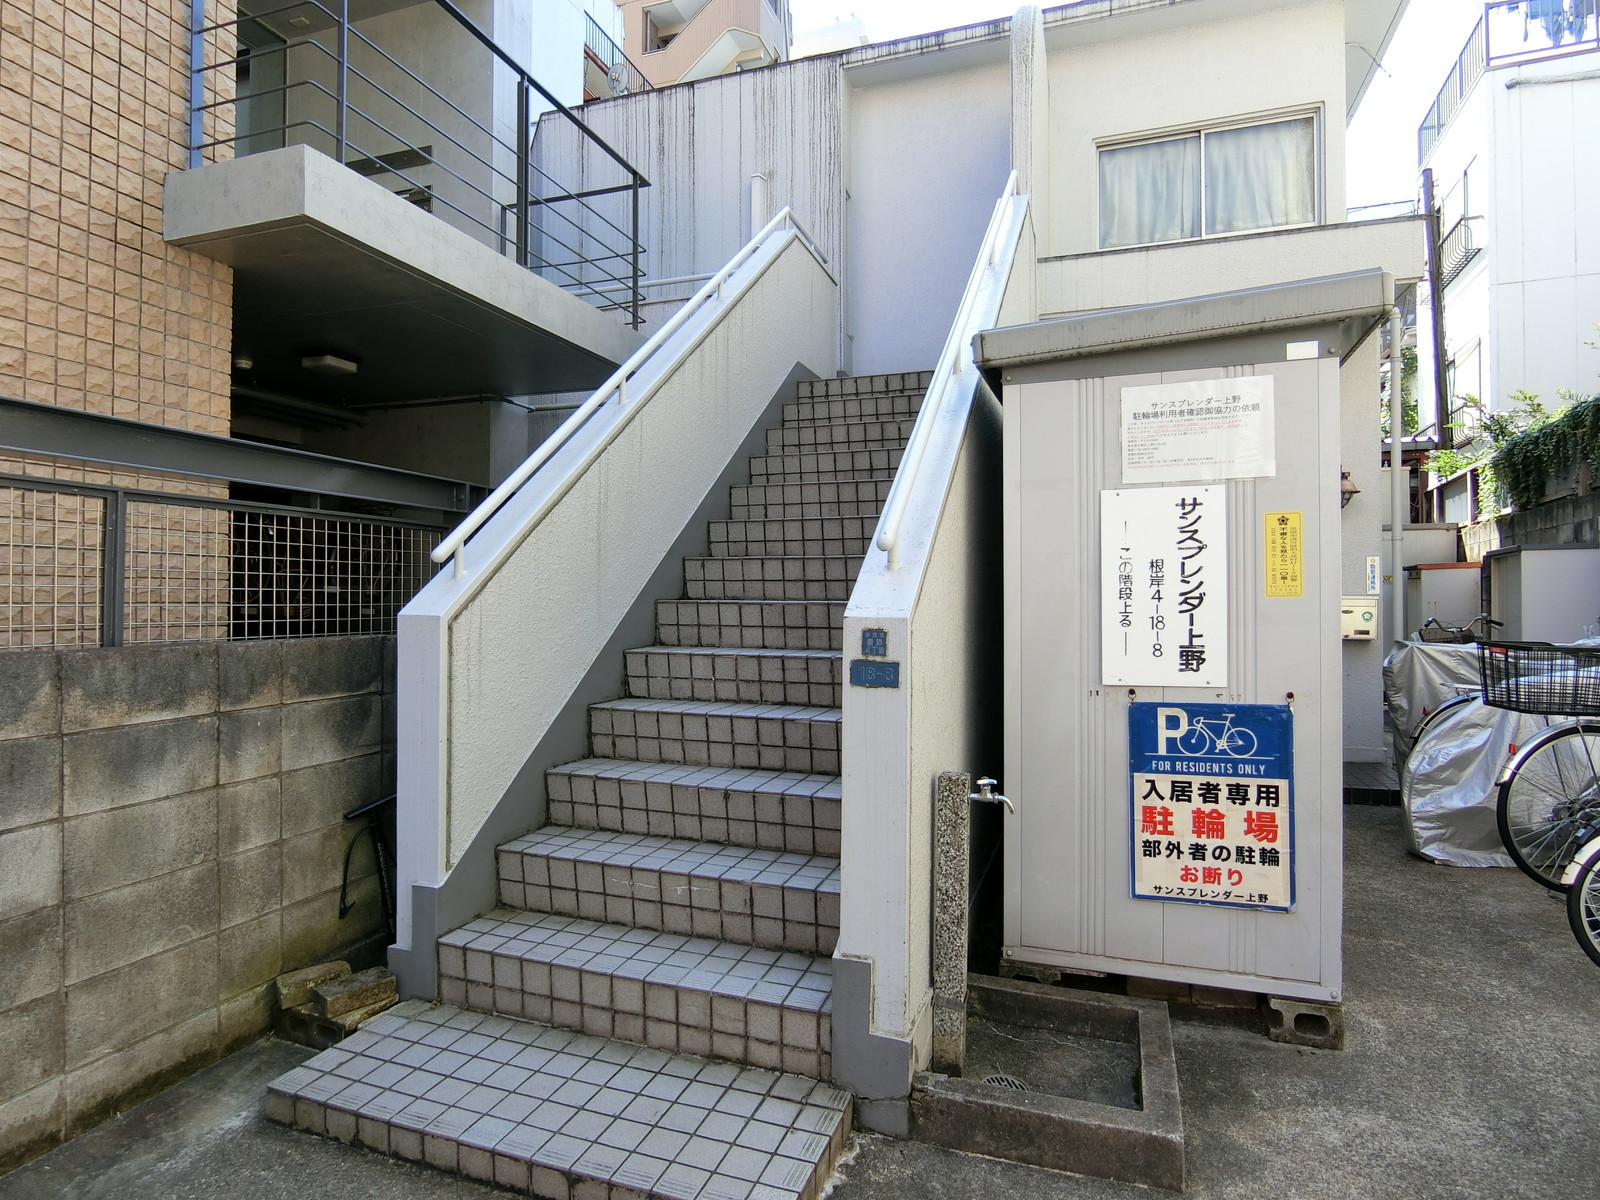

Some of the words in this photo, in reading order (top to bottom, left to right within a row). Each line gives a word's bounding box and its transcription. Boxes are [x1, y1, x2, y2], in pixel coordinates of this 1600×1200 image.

[1132, 403, 1261, 421] 駐輪場利用者確認御協力の依頼
[1175, 497, 1207, 673] サンスプレンダー上野
[859, 666, 894, 682] 18-8
[1156, 707, 1188, 755] P
[1151, 760, 1171, 771] FOR
[1176, 761, 1233, 774] RESIDENTS
[1238, 764, 1265, 775] ONLY
[1142, 779, 1280, 808] 入居者専用
[1141, 805, 1279, 843] 駐輪場
[1142, 839, 1280, 867] 部外者の駐輪
[1179, 865, 1243, 886] お断り
